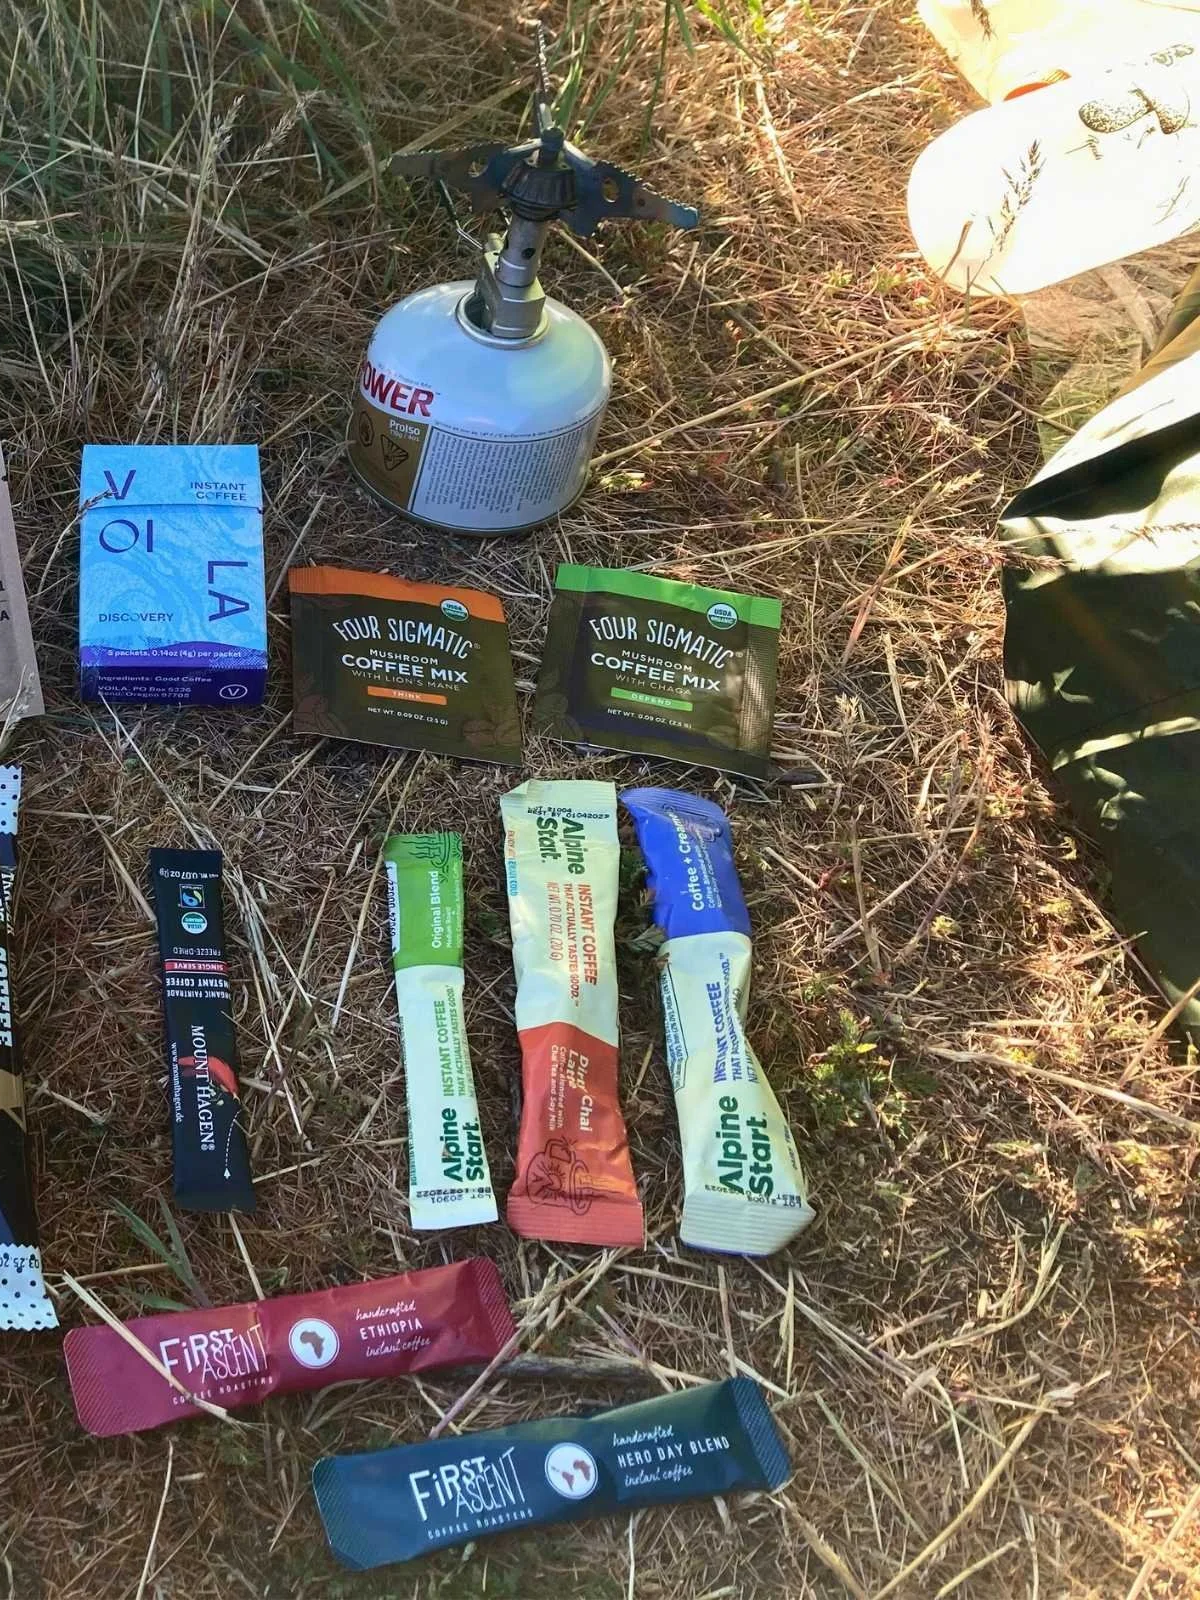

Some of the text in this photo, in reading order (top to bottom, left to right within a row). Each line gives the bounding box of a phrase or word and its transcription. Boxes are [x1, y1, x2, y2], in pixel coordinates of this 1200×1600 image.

[360, 360, 434, 417] OWER
[104, 470, 136, 500] V
[190, 482, 247, 491] INSTANT
[196, 492, 247, 500] COFFEE
[99, 613, 173, 622] DISCOVERY
[713, 608, 732, 617] USDA
[332, 615, 473, 659] FOUR SIGMATIC
[589, 617, 734, 669] FOUR SIGMATIC
[213, 650, 241, 658] packet
[369, 649, 438, 665] MUSHROOM
[621, 650, 693, 672] MUSHROOM
[341, 654, 469, 683] COFFEE MIX
[352, 669, 461, 691] WITH LION'S MANE
[591, 653, 721, 691] COFFEE MIX
[392, 691, 422, 700] THINK
[615, 674, 693, 695] WITH CHAGA
[631, 693, 672, 706] DEFEND
[607, 708, 621, 716] NET
[559, 817, 586, 876] Alpine
[564, 883, 574, 901] THAT
[688, 867, 705, 911] Coffee
[428, 870, 442, 949] Original Blend
[566, 901, 576, 941] ACTUALLY
[577, 884, 598, 986] INSTANT COFFEE
[172, 947, 221, 956] FREEZE-DRIED
[568, 944, 578, 973] TASTES
[174, 962, 224, 971] SINGLE SERVE
[165, 977, 195, 987] COFFEE
[166, 989, 203, 998] FAIRTRADE
[706, 981, 725, 1033] COFFEE
[449, 1008, 460, 1035] TASTES
[191, 1025, 210, 1083] MOUNT
[433, 1000, 455, 1097] INSTANT COFFEE
[453, 1036, 464, 1075] ACTUALLY
[713, 1035, 728, 1083] INSTANT
[551, 1063, 559, 1078] Tea
[732, 1057, 742, 1081] THAT
[171, 1042, 185, 1124] www.mounthagen.de
[456, 1076, 467, 1097] THAT
[550, 1078, 558, 1095] and
[547, 1095, 557, 1113] Soy
[579, 1095, 593, 1132] Chai
[440, 1107, 465, 1183] Alpine
[716, 1095, 747, 1195] Alpine
[355, 1300, 416, 1320] handcrafted
[360, 1318, 424, 1340] ETHIOPIA
[201, 1324, 268, 1385] ASCENT
[366, 1337, 431, 1357] instant coffee
[611, 1425, 675, 1448] handcrafted
[617, 1436, 730, 1468] HERO DAY BLEND
[456, 1446, 526, 1518] ASCENT
[624, 1465, 695, 1487] instant coffee
[427, 1508, 534, 1540] COFFEE ROASTERS
